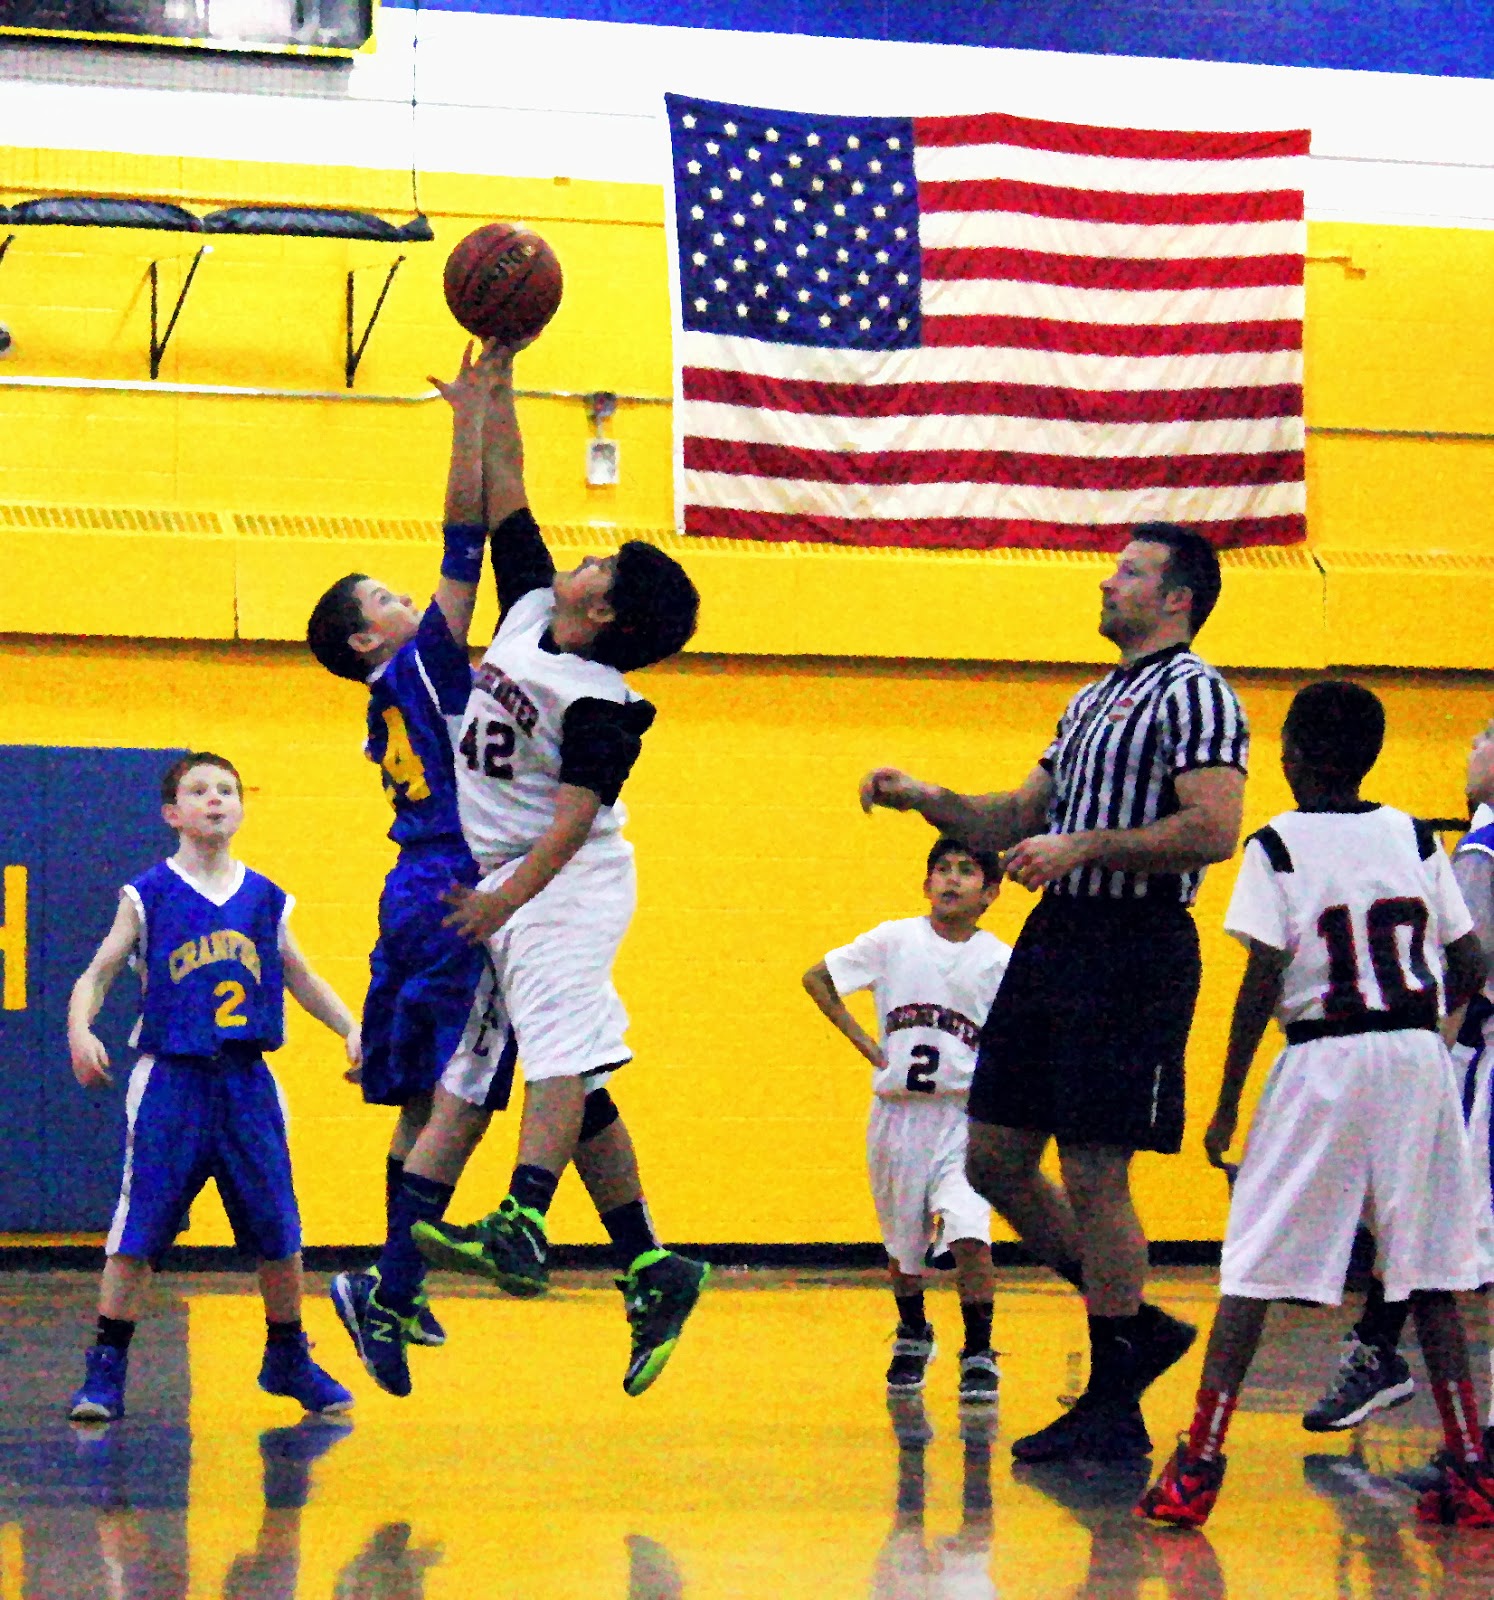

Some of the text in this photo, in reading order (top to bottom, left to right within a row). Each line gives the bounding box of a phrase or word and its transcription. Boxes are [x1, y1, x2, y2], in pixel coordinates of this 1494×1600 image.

[459, 717, 515, 780] 42
[1317, 896, 1438, 1022] 10
[211, 980, 248, 1028] 2
[906, 1044, 940, 1094] 2
